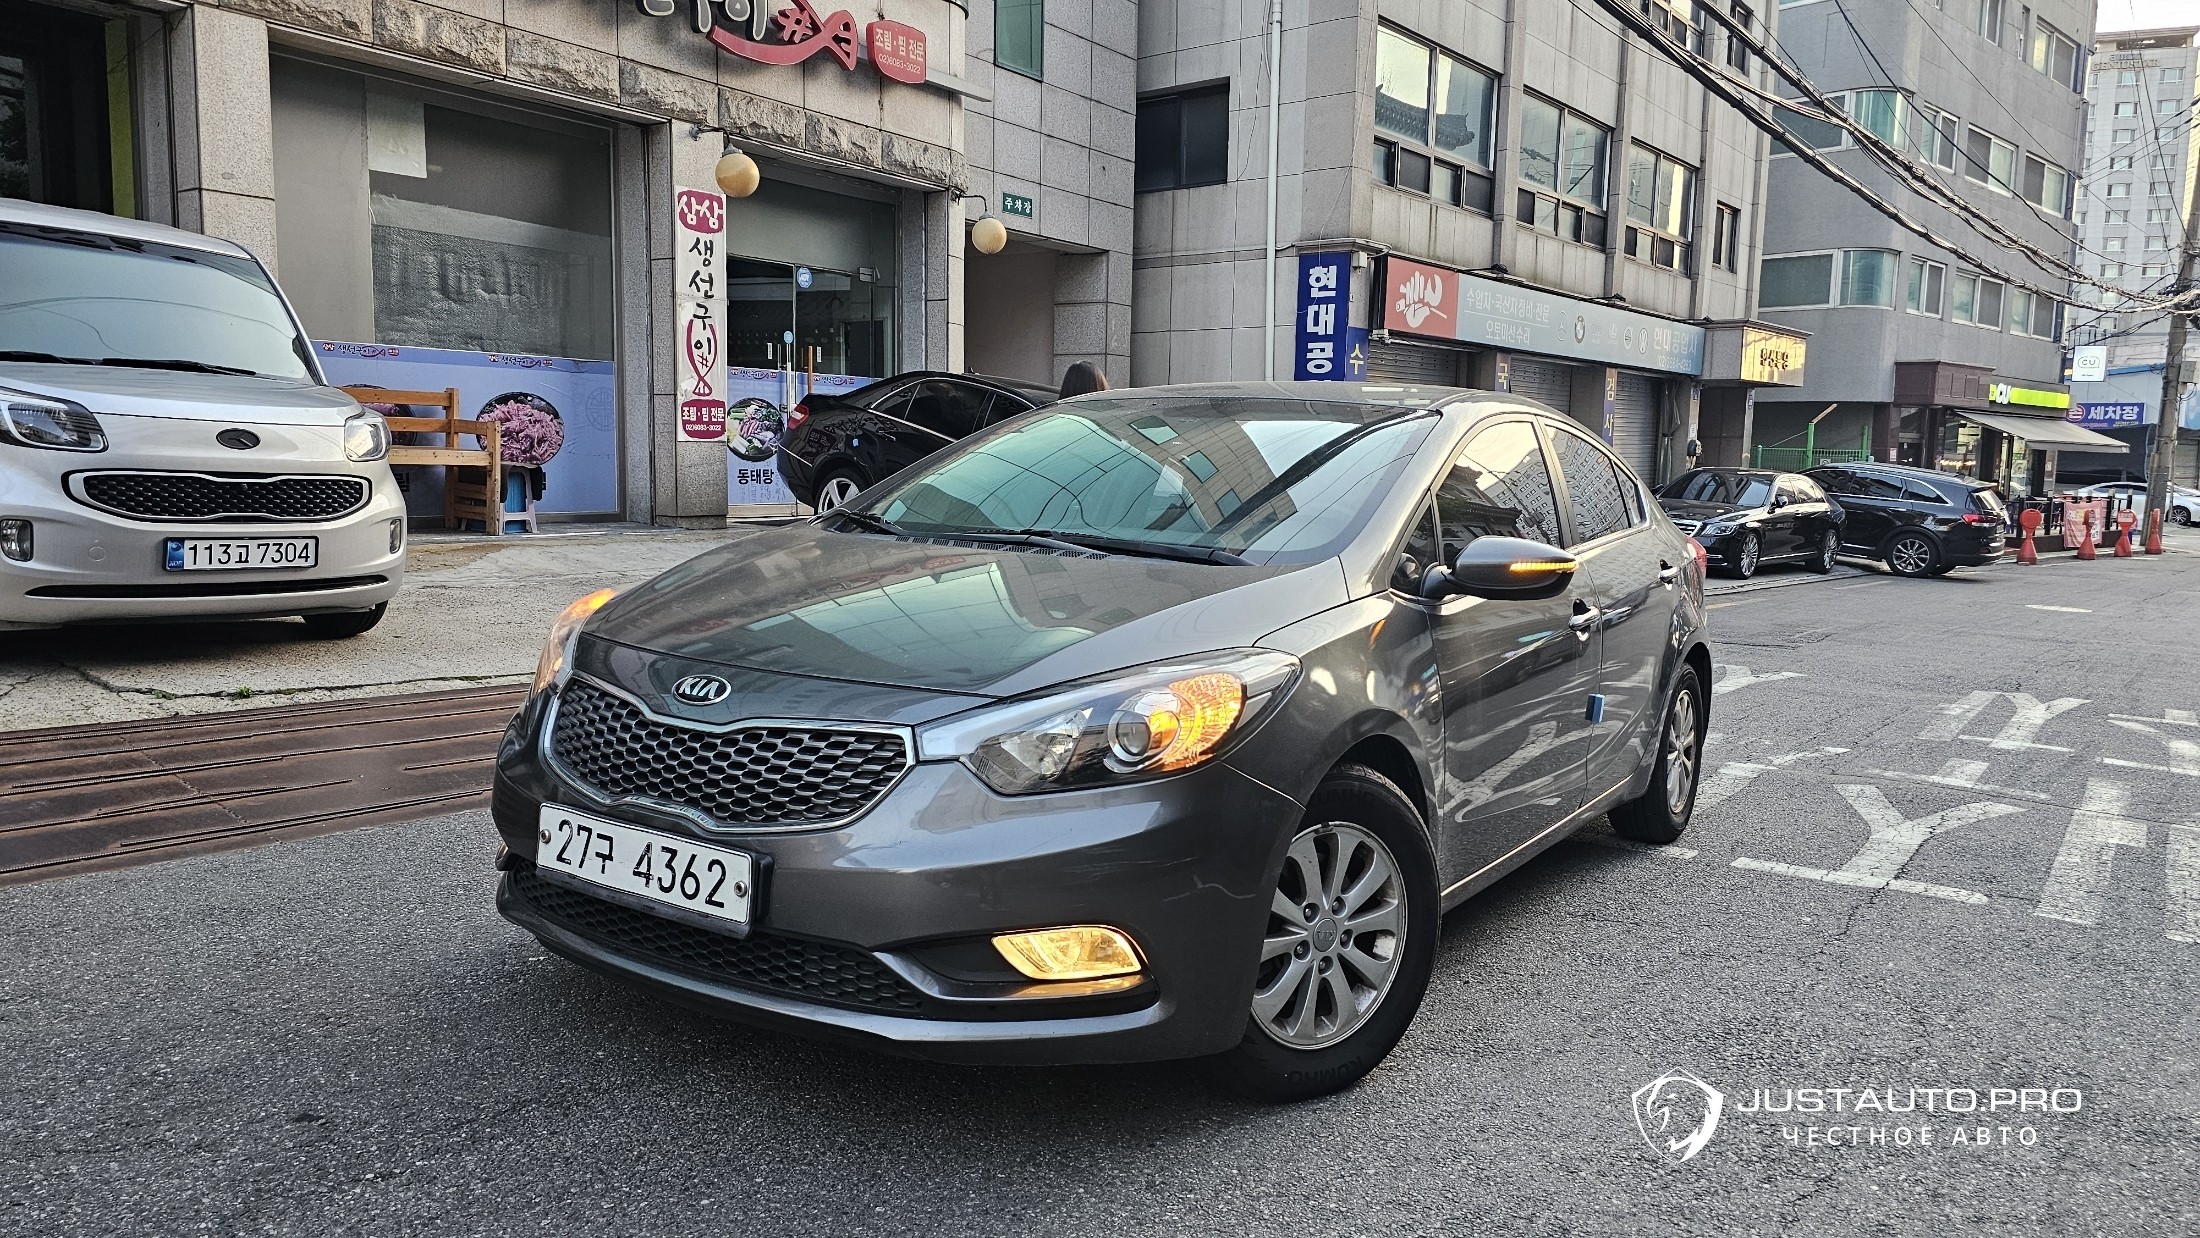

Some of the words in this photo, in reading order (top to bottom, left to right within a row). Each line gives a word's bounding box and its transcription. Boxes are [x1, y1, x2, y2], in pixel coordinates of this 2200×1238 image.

[909, 39, 924, 62] 전문
[1004, 197, 1032, 214] 주차장
[688, 236, 715, 356] 생선구이
[1305, 265, 1338, 382] 현대공
[1653, 326, 1698, 357] 현대공업사
[1995, 382, 2012, 405] CU
[710, 406, 725, 422] 전문
[2087, 405, 2140, 420] 세차장
[737, 468, 774, 485] 동태탕
[189, 543, 249, 566] 113고
[257, 542, 310, 564] 7304
[679, 677, 717, 698] KIA
[556, 818, 614, 875] 27구
[633, 841, 727, 909] 4362
